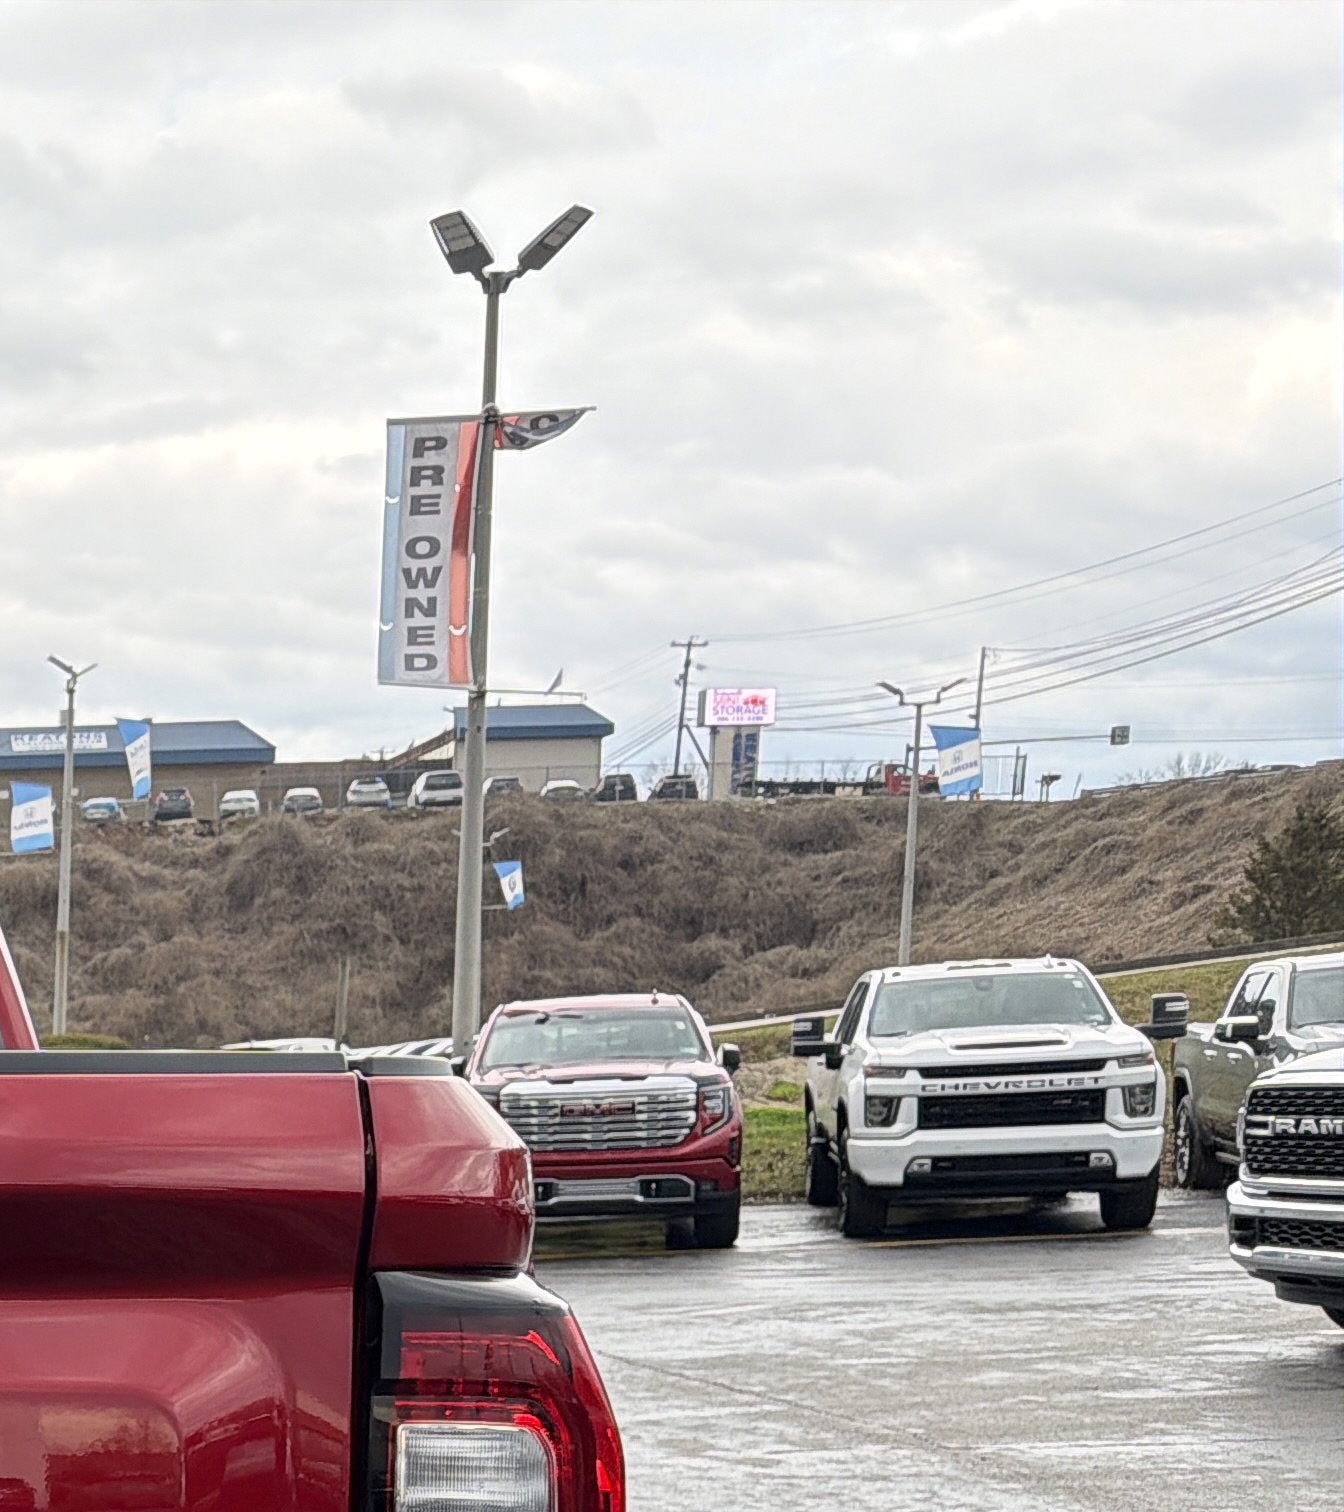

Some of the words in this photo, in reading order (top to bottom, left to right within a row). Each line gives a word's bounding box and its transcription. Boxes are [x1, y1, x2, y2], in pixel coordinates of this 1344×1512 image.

[409, 436, 448, 516] PRE
[402, 535, 444, 672] OWNED
[712, 704, 769, 716] STORAGE
[920, 1076, 1106, 1094] CHEVROLET
[560, 1101, 636, 1117] GMC
[1275, 1118, 1343, 1135] RAM
